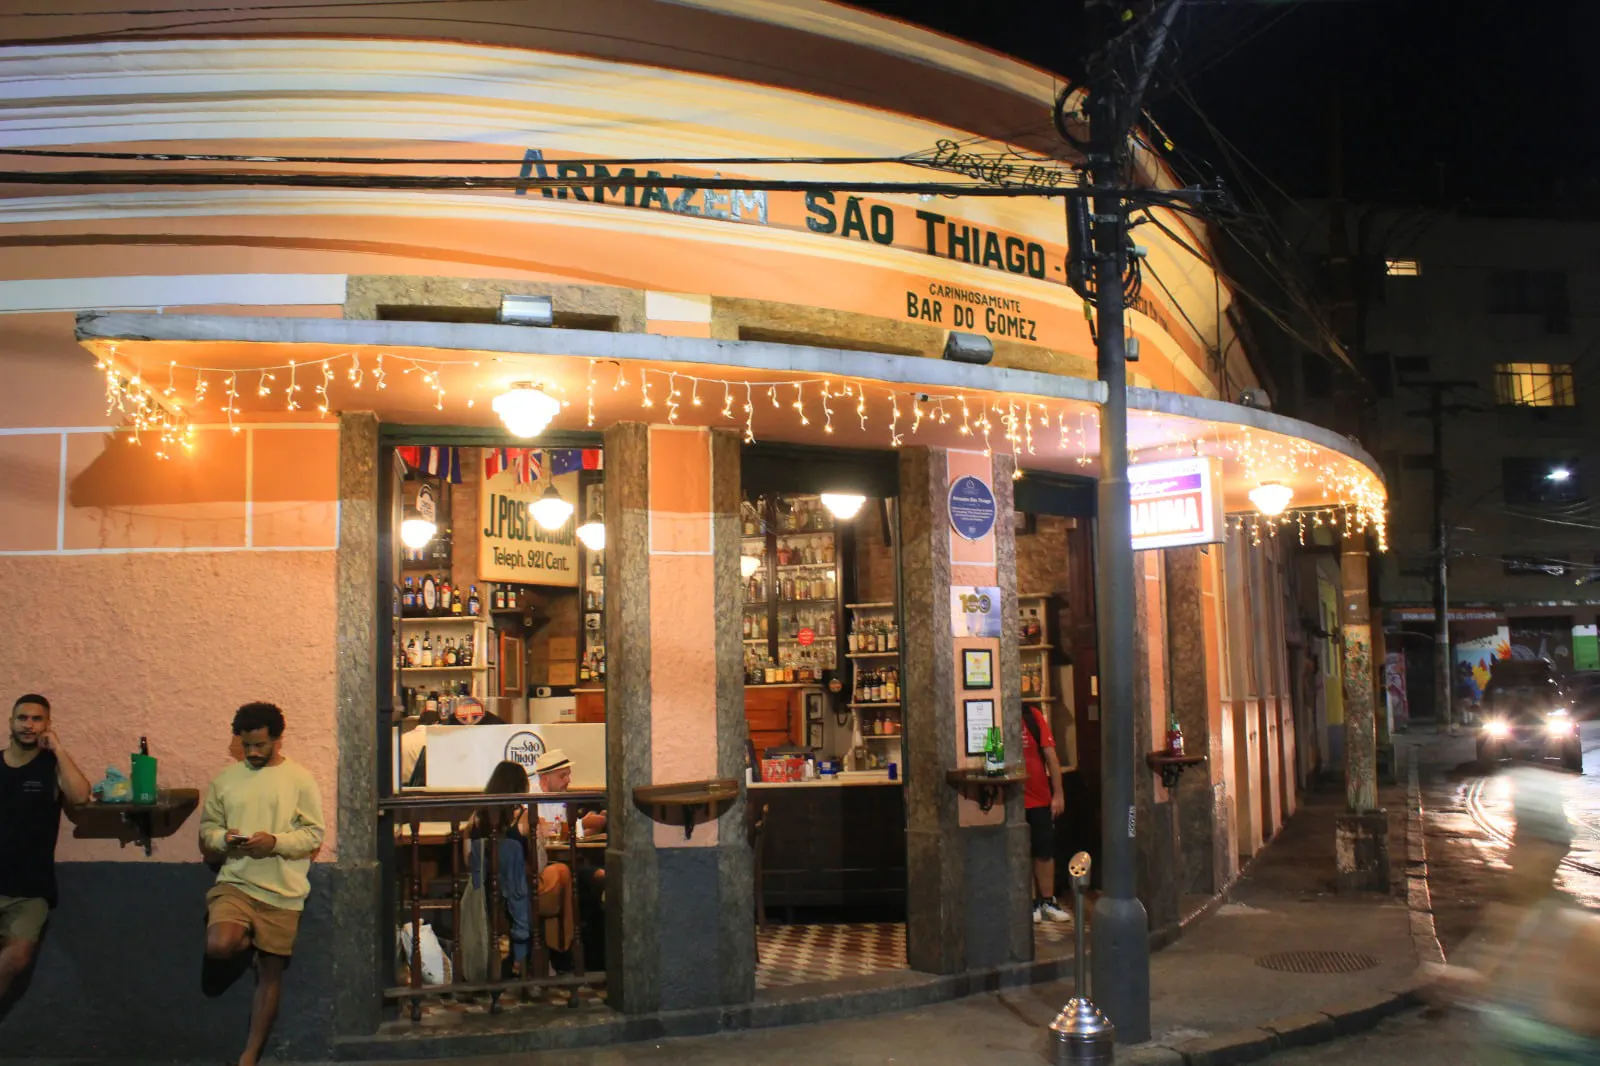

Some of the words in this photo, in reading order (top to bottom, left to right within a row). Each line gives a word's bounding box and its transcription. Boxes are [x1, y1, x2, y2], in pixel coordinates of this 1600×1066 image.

[805, 190, 894, 245] SÃO
[916, 210, 1045, 279] THIAGO
[907, 292, 942, 323] BAR
[954, 307, 975, 329] DO
[985, 307, 1037, 341] GOMEZ
[929, 283, 1021, 313] CARINHOSAMENTE
[493, 546, 526, 569] Teleph.
